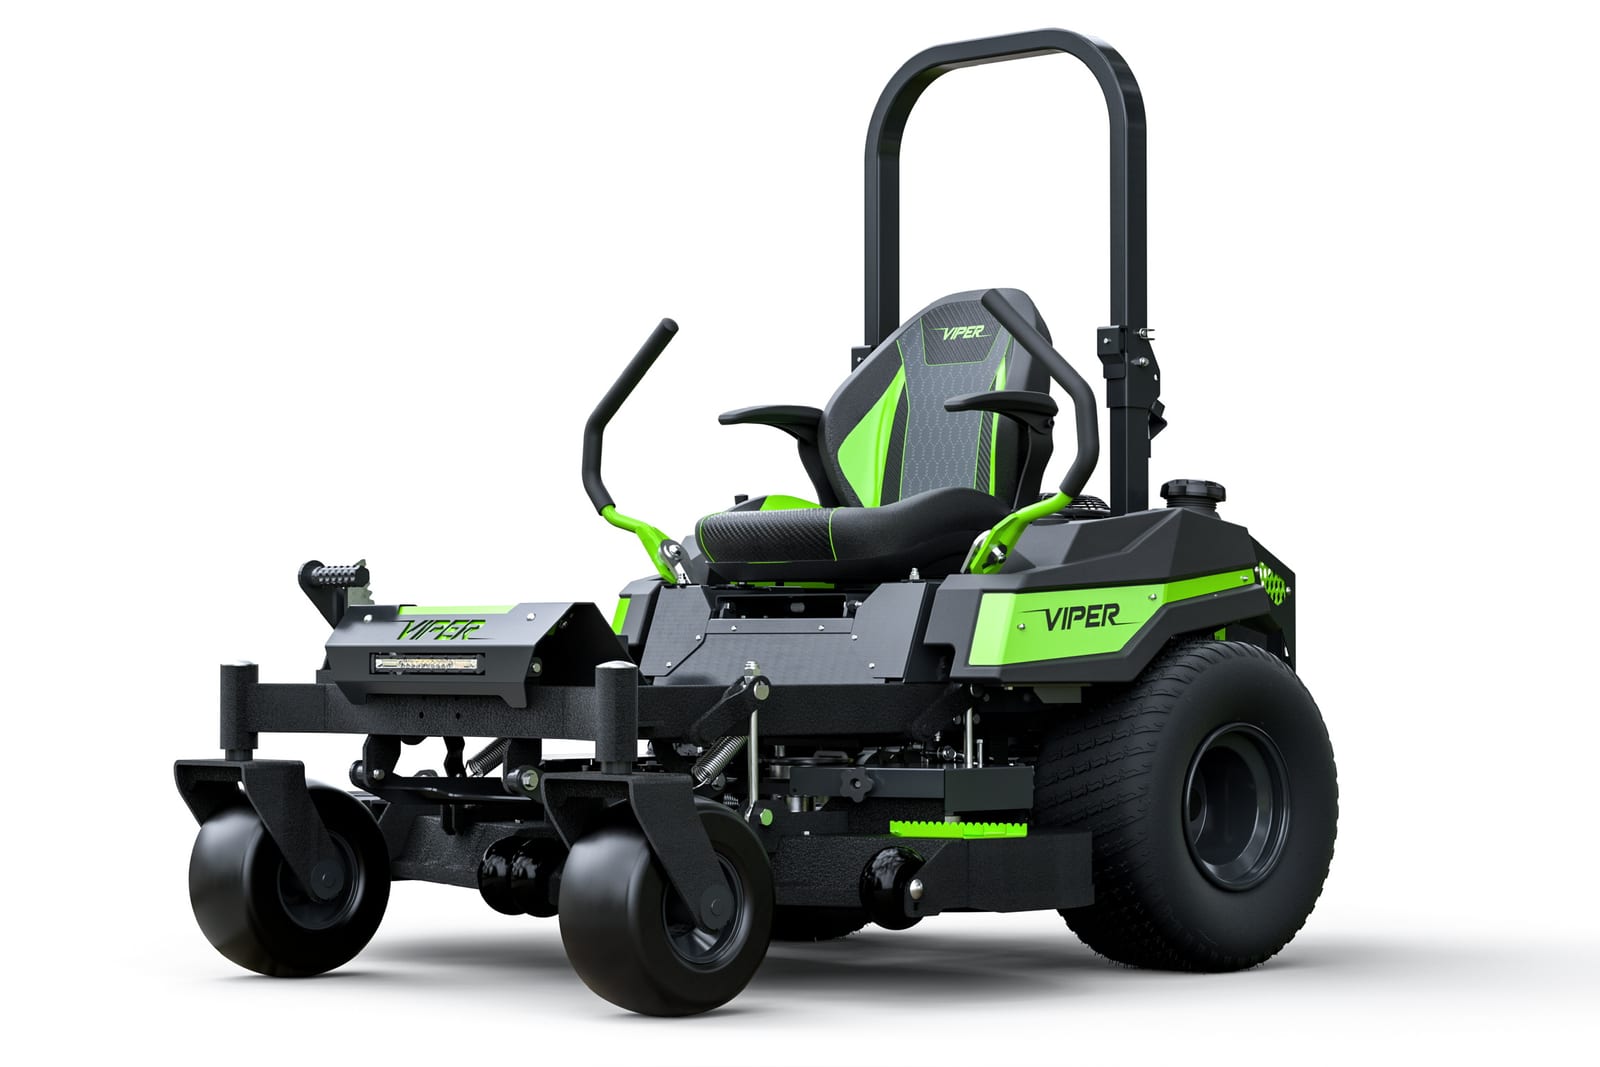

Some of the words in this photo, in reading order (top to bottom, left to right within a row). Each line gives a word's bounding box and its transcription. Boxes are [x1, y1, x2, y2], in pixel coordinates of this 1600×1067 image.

[942, 325, 985, 341] VIPER
[1043, 603, 1120, 631] VIPER
[397, 619, 487, 641] VIPER
